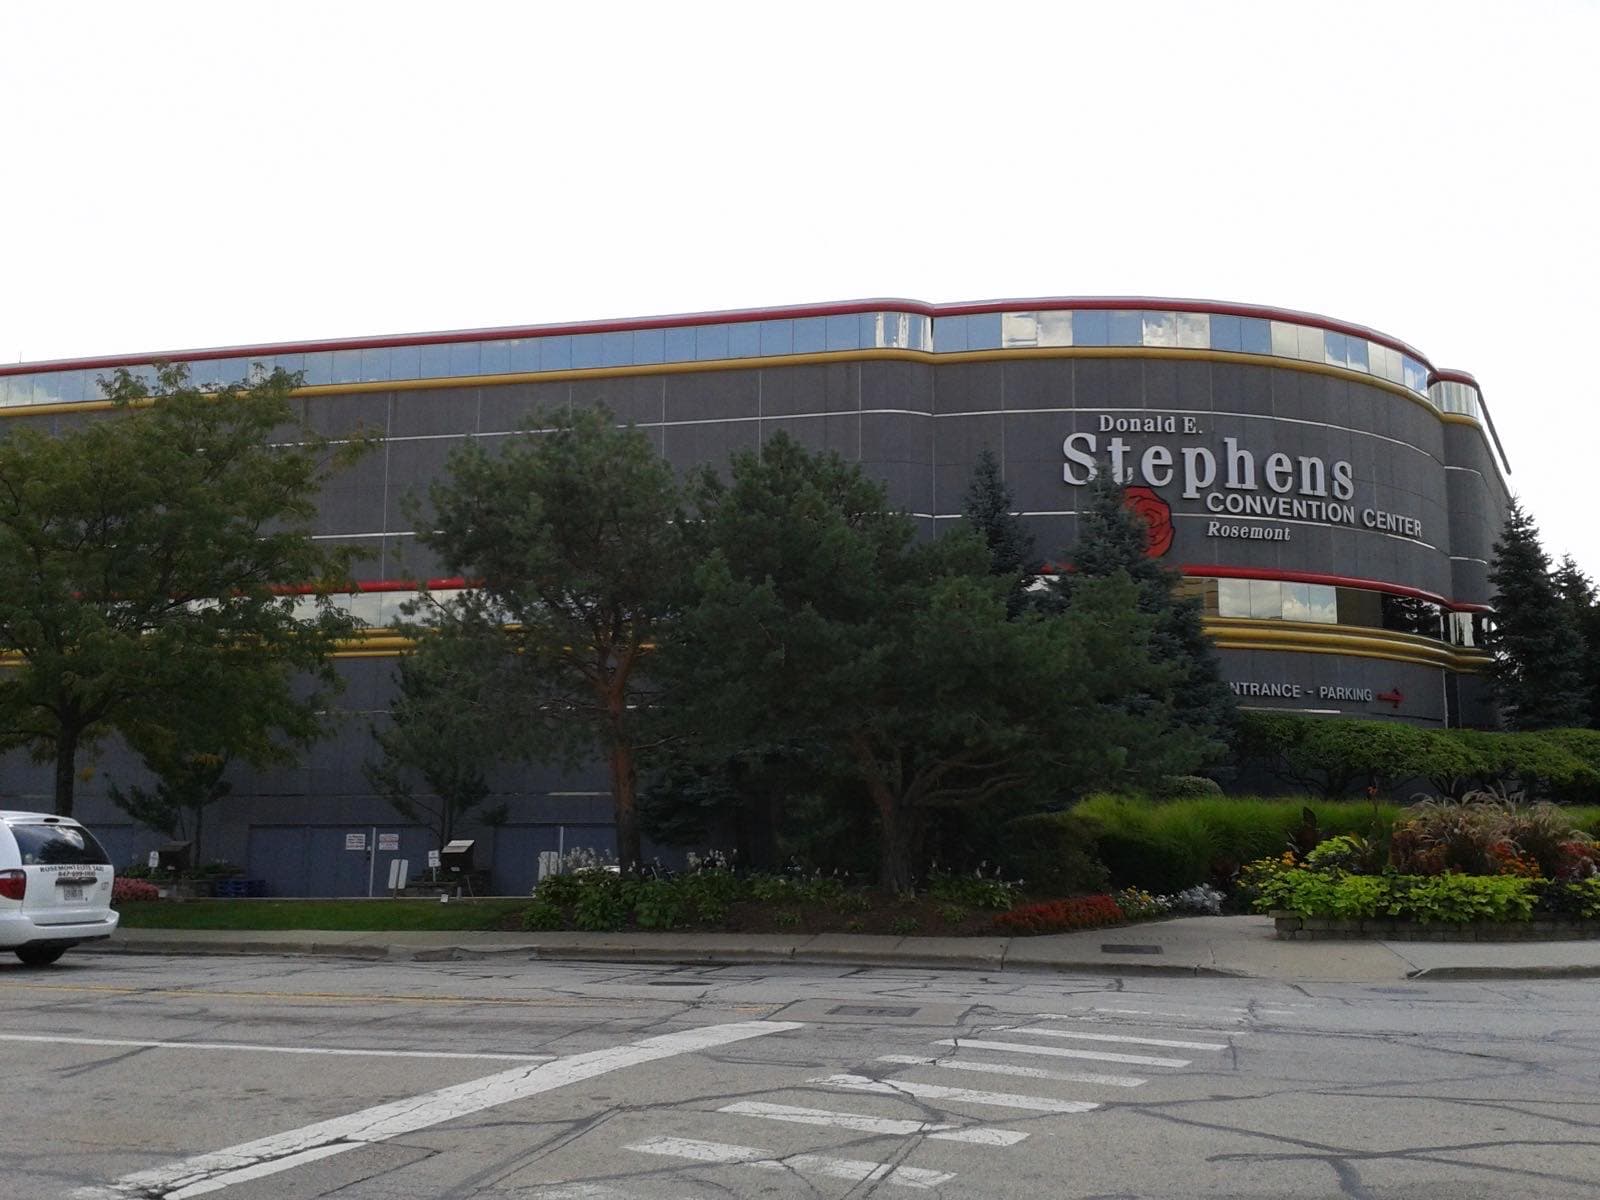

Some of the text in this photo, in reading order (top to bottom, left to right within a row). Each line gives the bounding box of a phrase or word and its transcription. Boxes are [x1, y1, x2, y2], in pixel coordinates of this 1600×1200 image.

[1099, 414, 1203, 434] Donald E.
[1063, 432, 1354, 500] Stephens
[1206, 492, 1422, 537] CONVENTION CENTER
[1208, 521, 1291, 540] Rosemont
[1229, 681, 1301, 698] NTRANCE
[1320, 686, 1373, 701] PARKING
